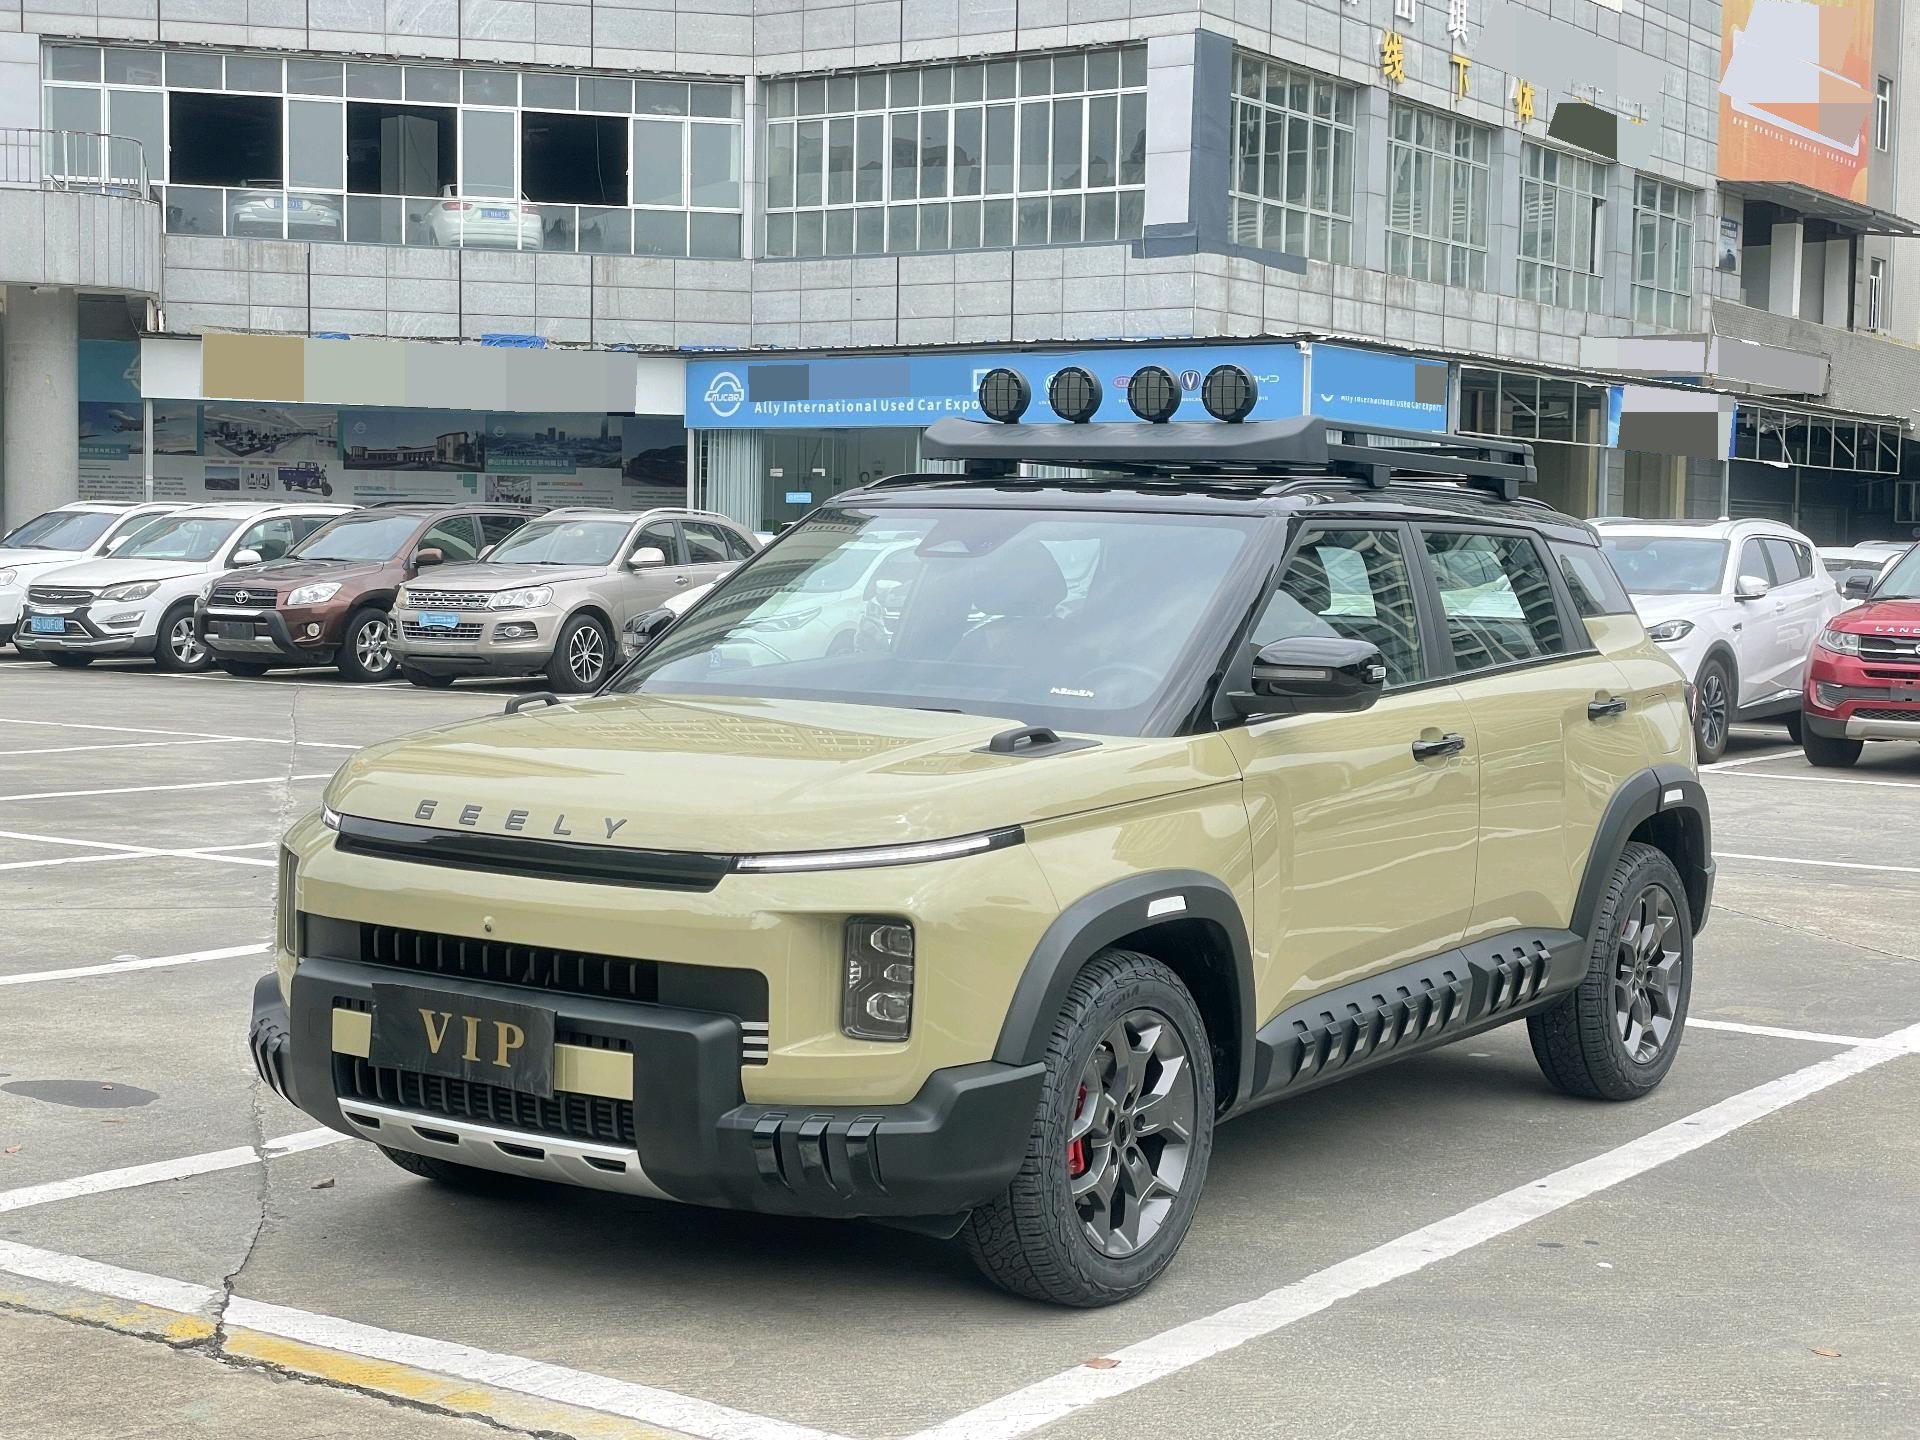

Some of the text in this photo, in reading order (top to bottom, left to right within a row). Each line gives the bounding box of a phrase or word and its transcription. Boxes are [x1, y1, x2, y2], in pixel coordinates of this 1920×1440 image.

[754, 401, 780, 416] Ally
[783, 399, 878, 414] International
[880, 399, 914, 412] Used
[917, 398, 942, 411] Car
[414, 799, 628, 839] GEELY
[418, 1008, 525, 1068] VIP
